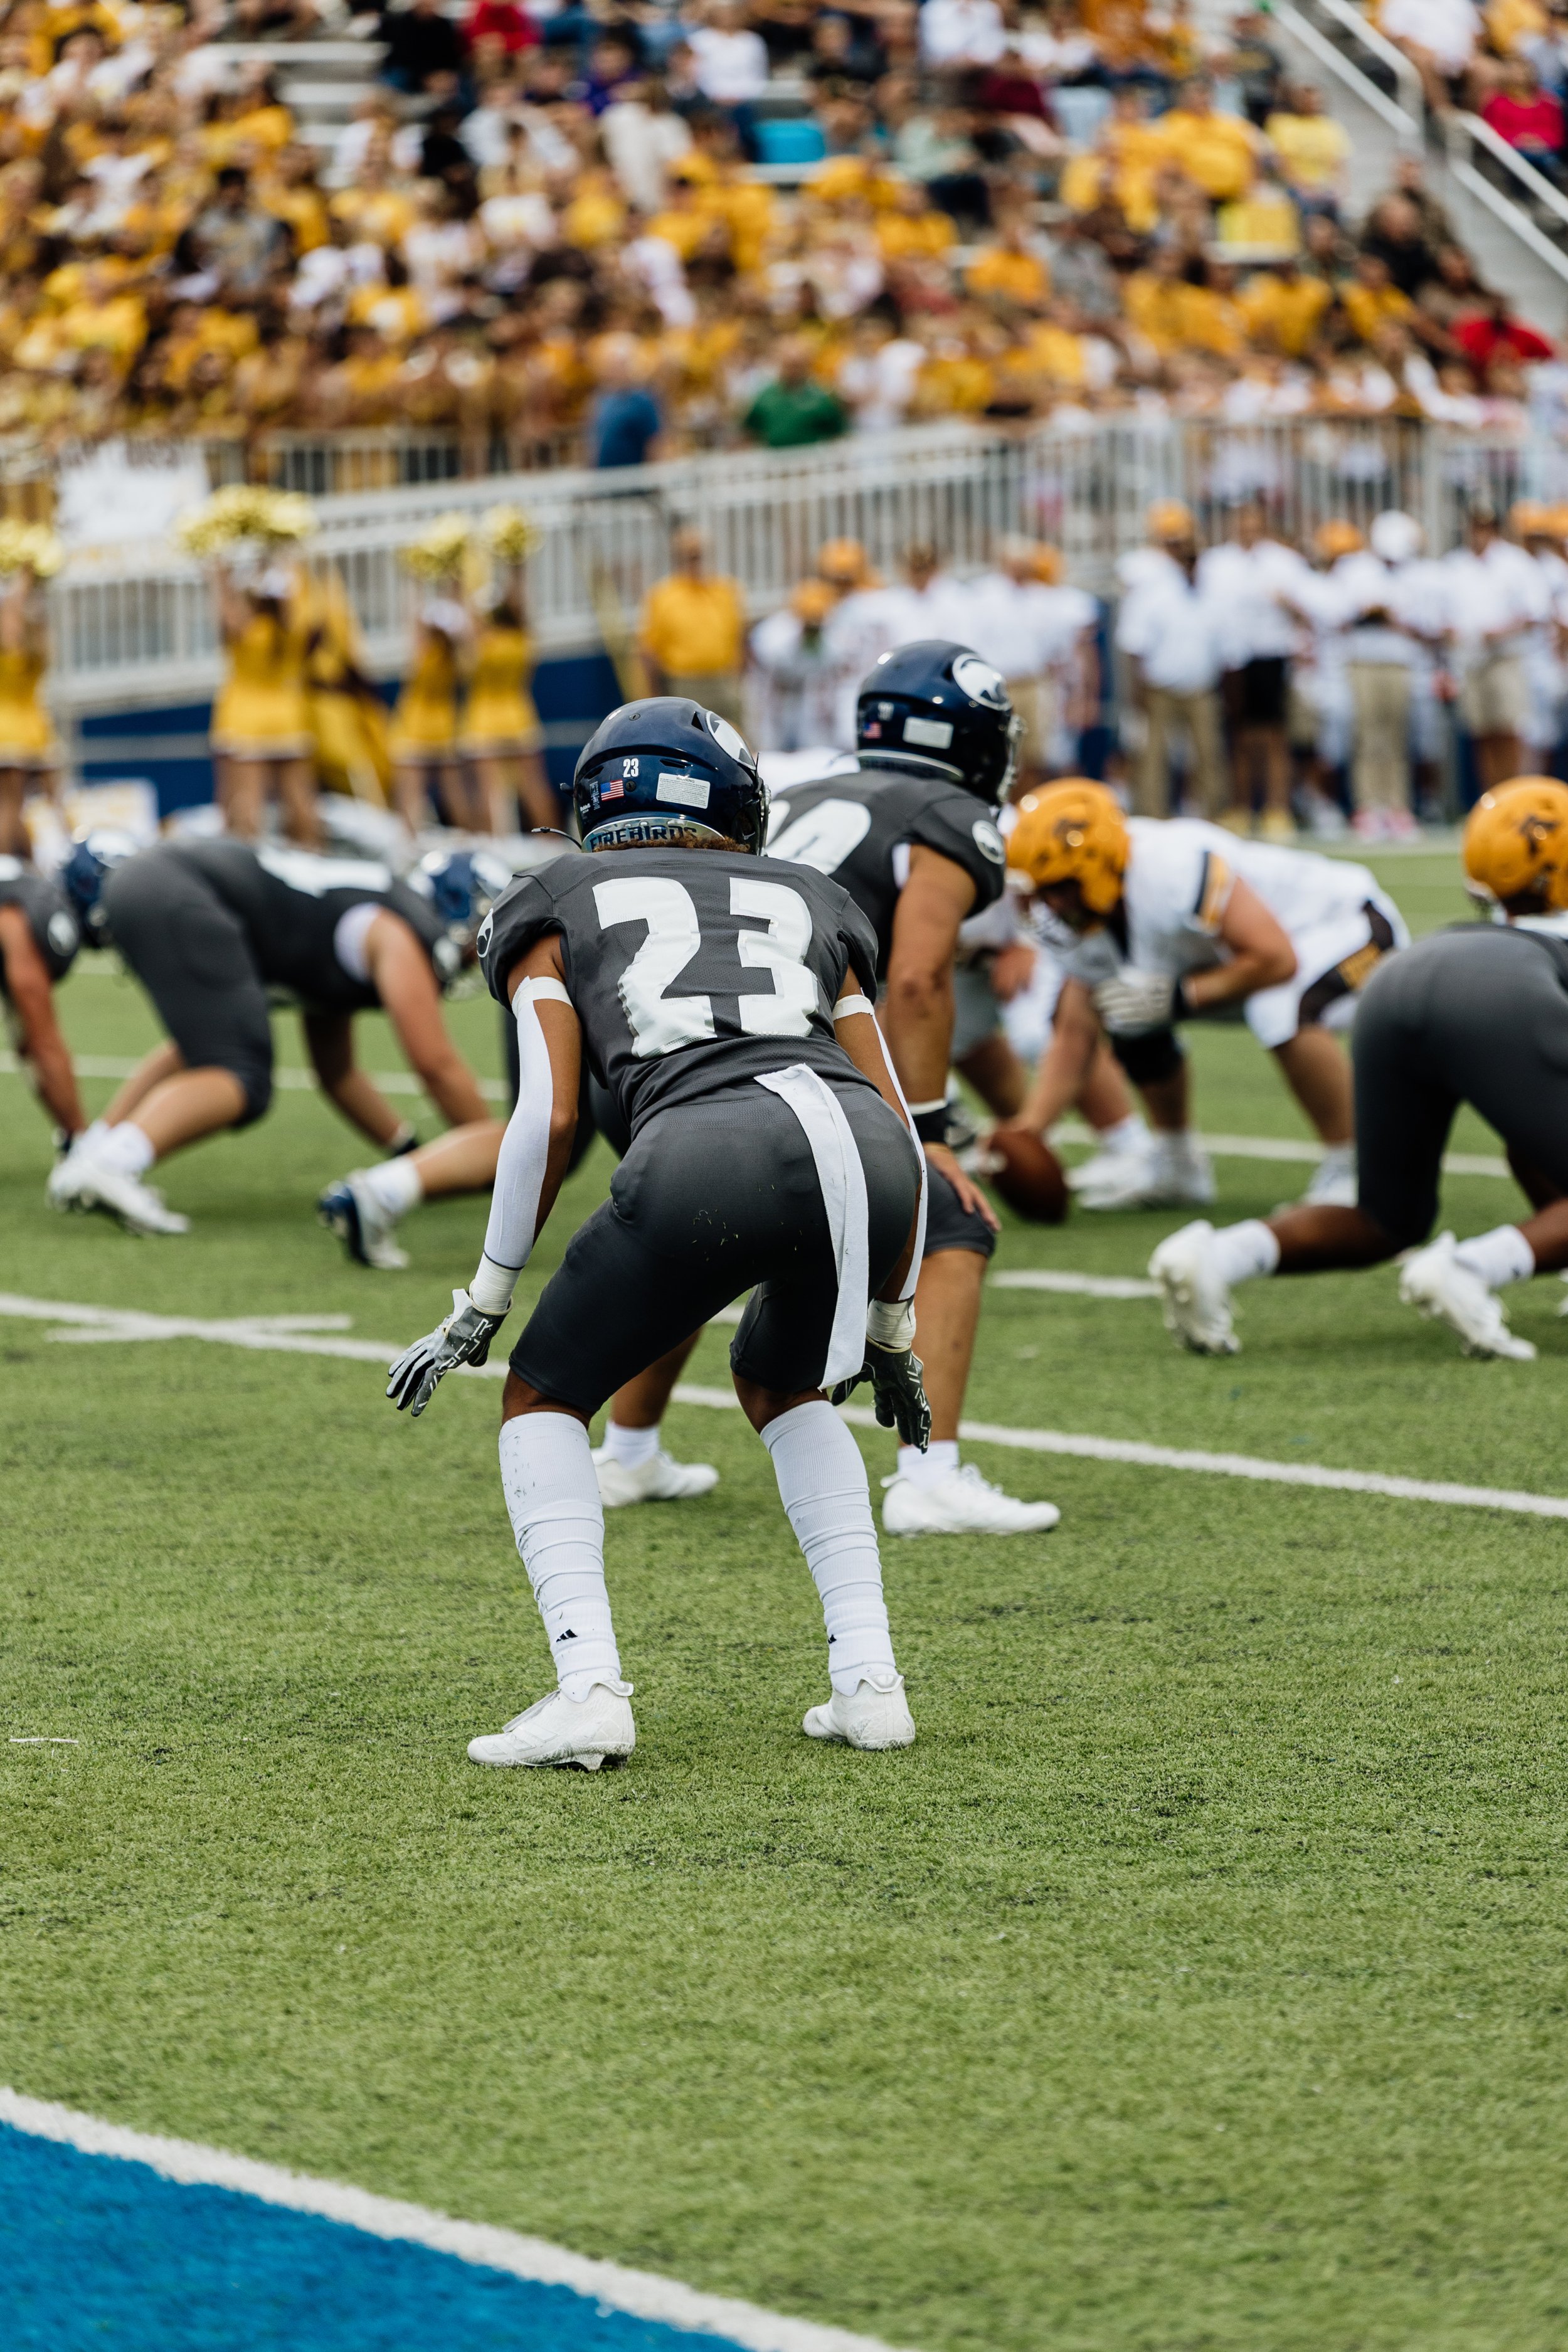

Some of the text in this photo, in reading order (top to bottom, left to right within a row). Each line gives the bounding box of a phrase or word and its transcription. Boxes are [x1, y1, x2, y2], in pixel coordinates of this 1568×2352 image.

[623, 758, 638, 777] 23
[591, 825, 697, 852] FIREBIRDS
[592, 877, 818, 1059] 23
